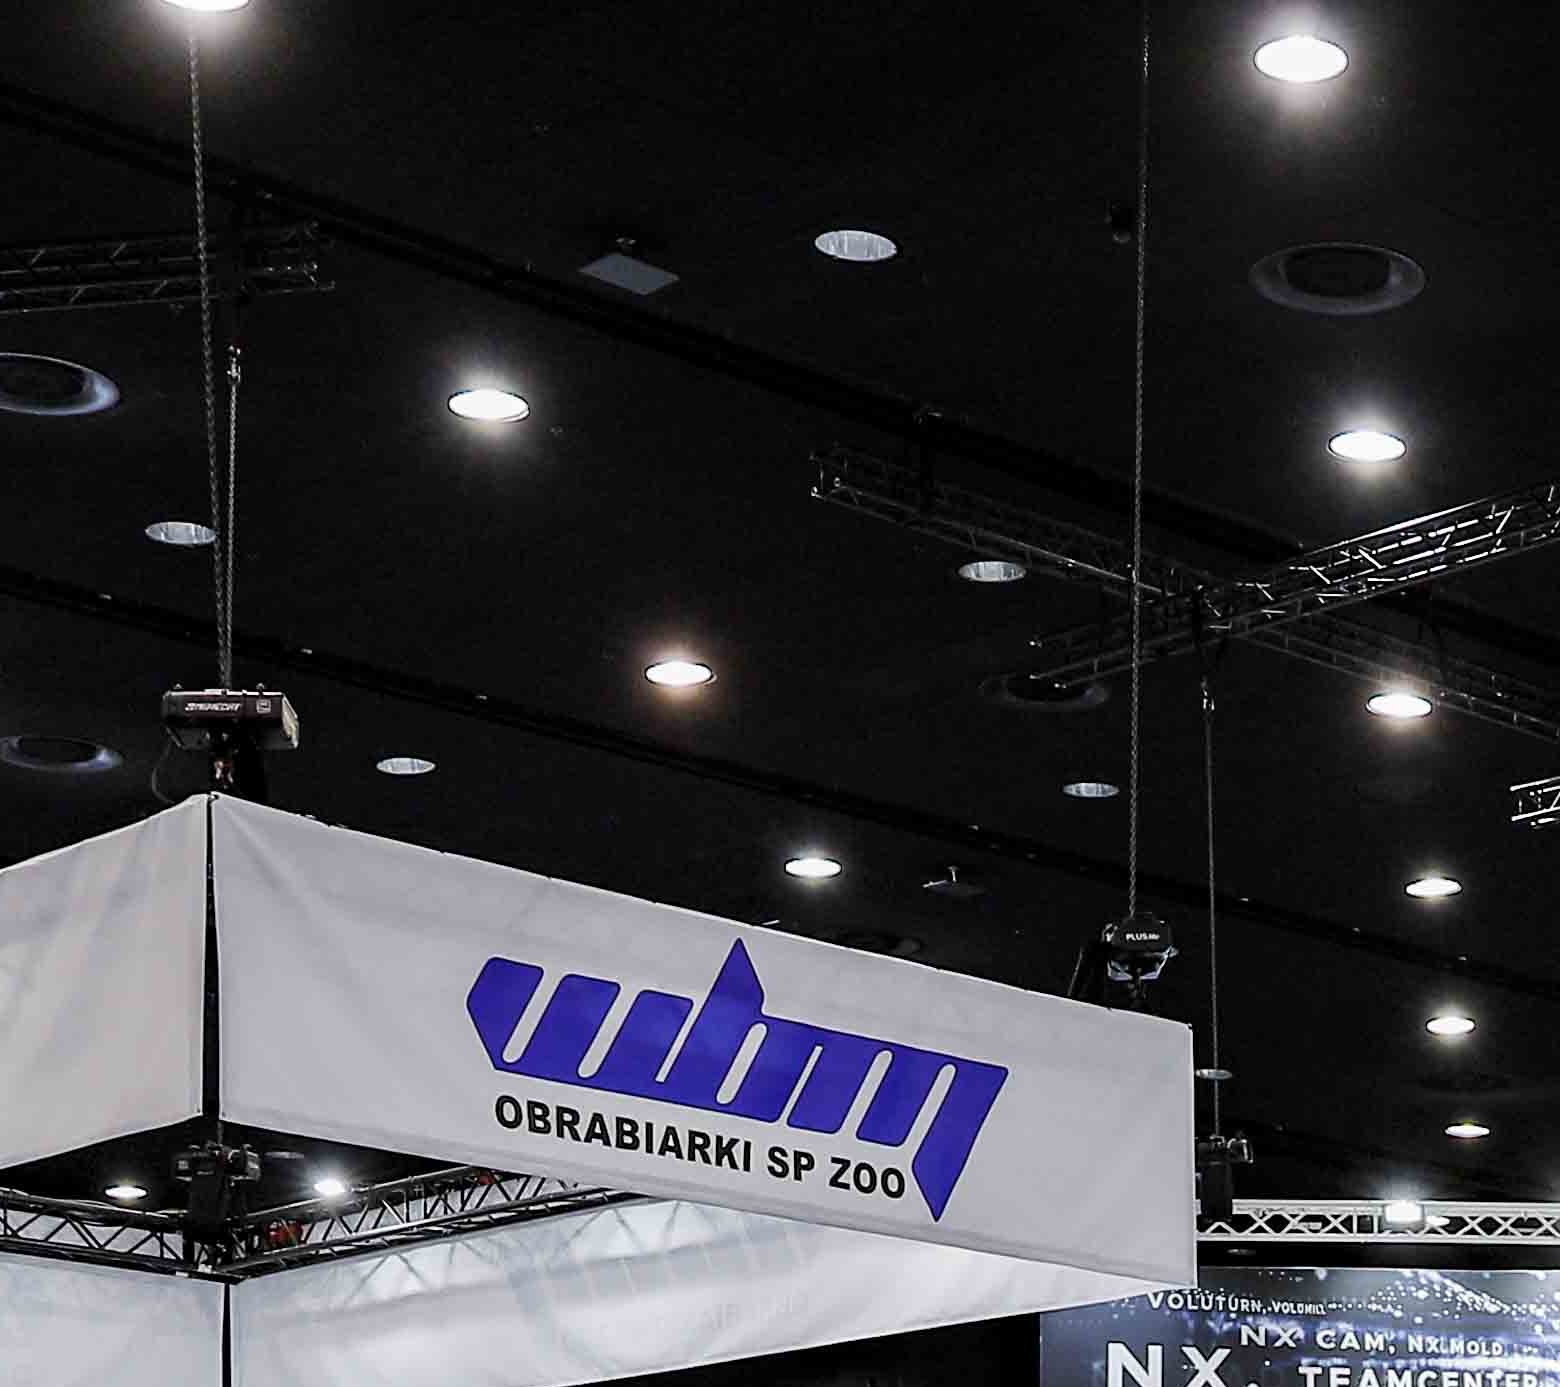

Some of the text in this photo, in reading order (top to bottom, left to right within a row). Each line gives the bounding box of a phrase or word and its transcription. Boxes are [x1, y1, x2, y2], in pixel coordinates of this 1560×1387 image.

[495, 1094, 907, 1200] OBRABIARKI SP ZOO
[1240, 1324, 1298, 1348] NX
[1316, 1327, 1396, 1355] CAM,
[1449, 1340, 1503, 1356] MOLD
